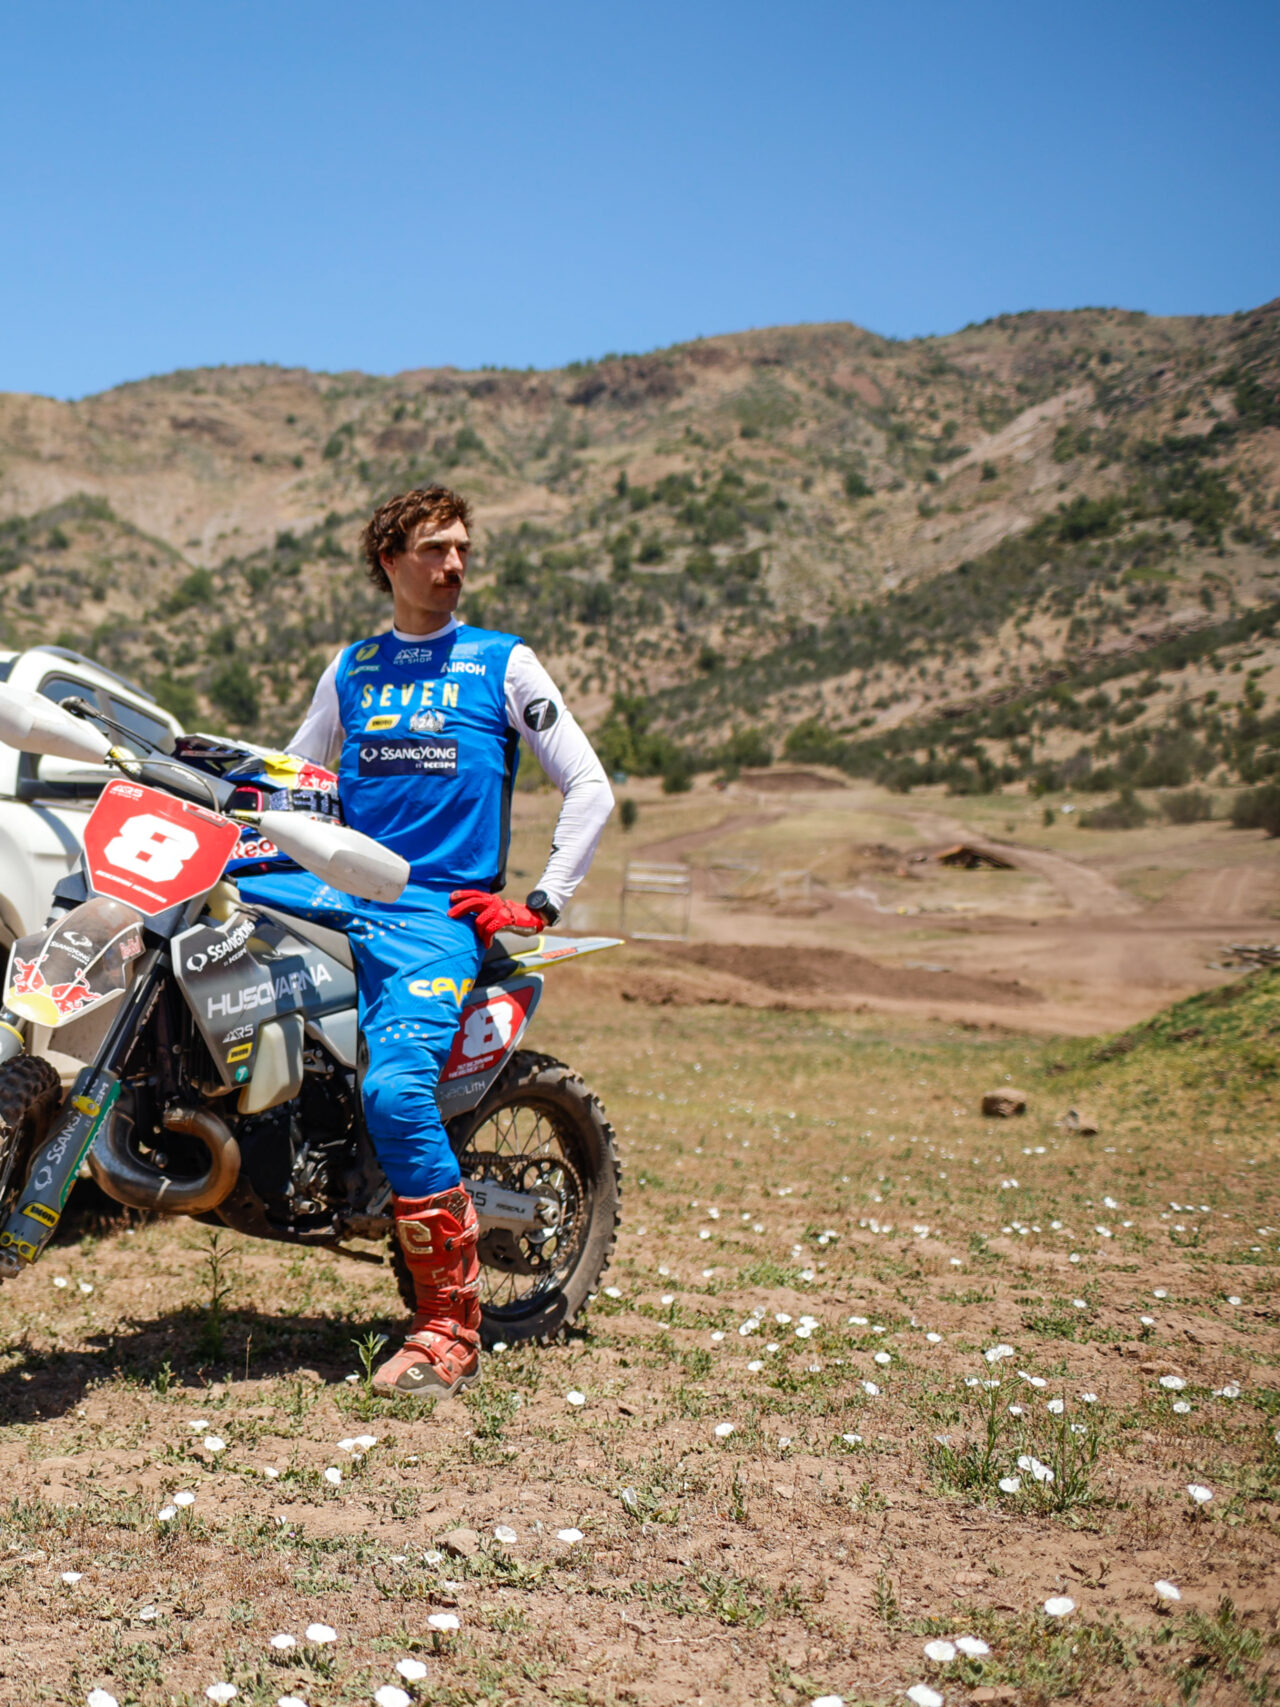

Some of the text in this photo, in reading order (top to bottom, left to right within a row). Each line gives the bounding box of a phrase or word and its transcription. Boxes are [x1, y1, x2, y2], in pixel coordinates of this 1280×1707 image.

[440, 661, 486, 676] AIROH
[361, 682, 459, 709] SEVEN
[380, 746, 456, 760] SSANGYONG
[104, 813, 200, 883] 8
[207, 919, 256, 963] SSANGYONG
[208, 964, 332, 1019] HUSQVARNA
[462, 1001, 513, 1058] 8
